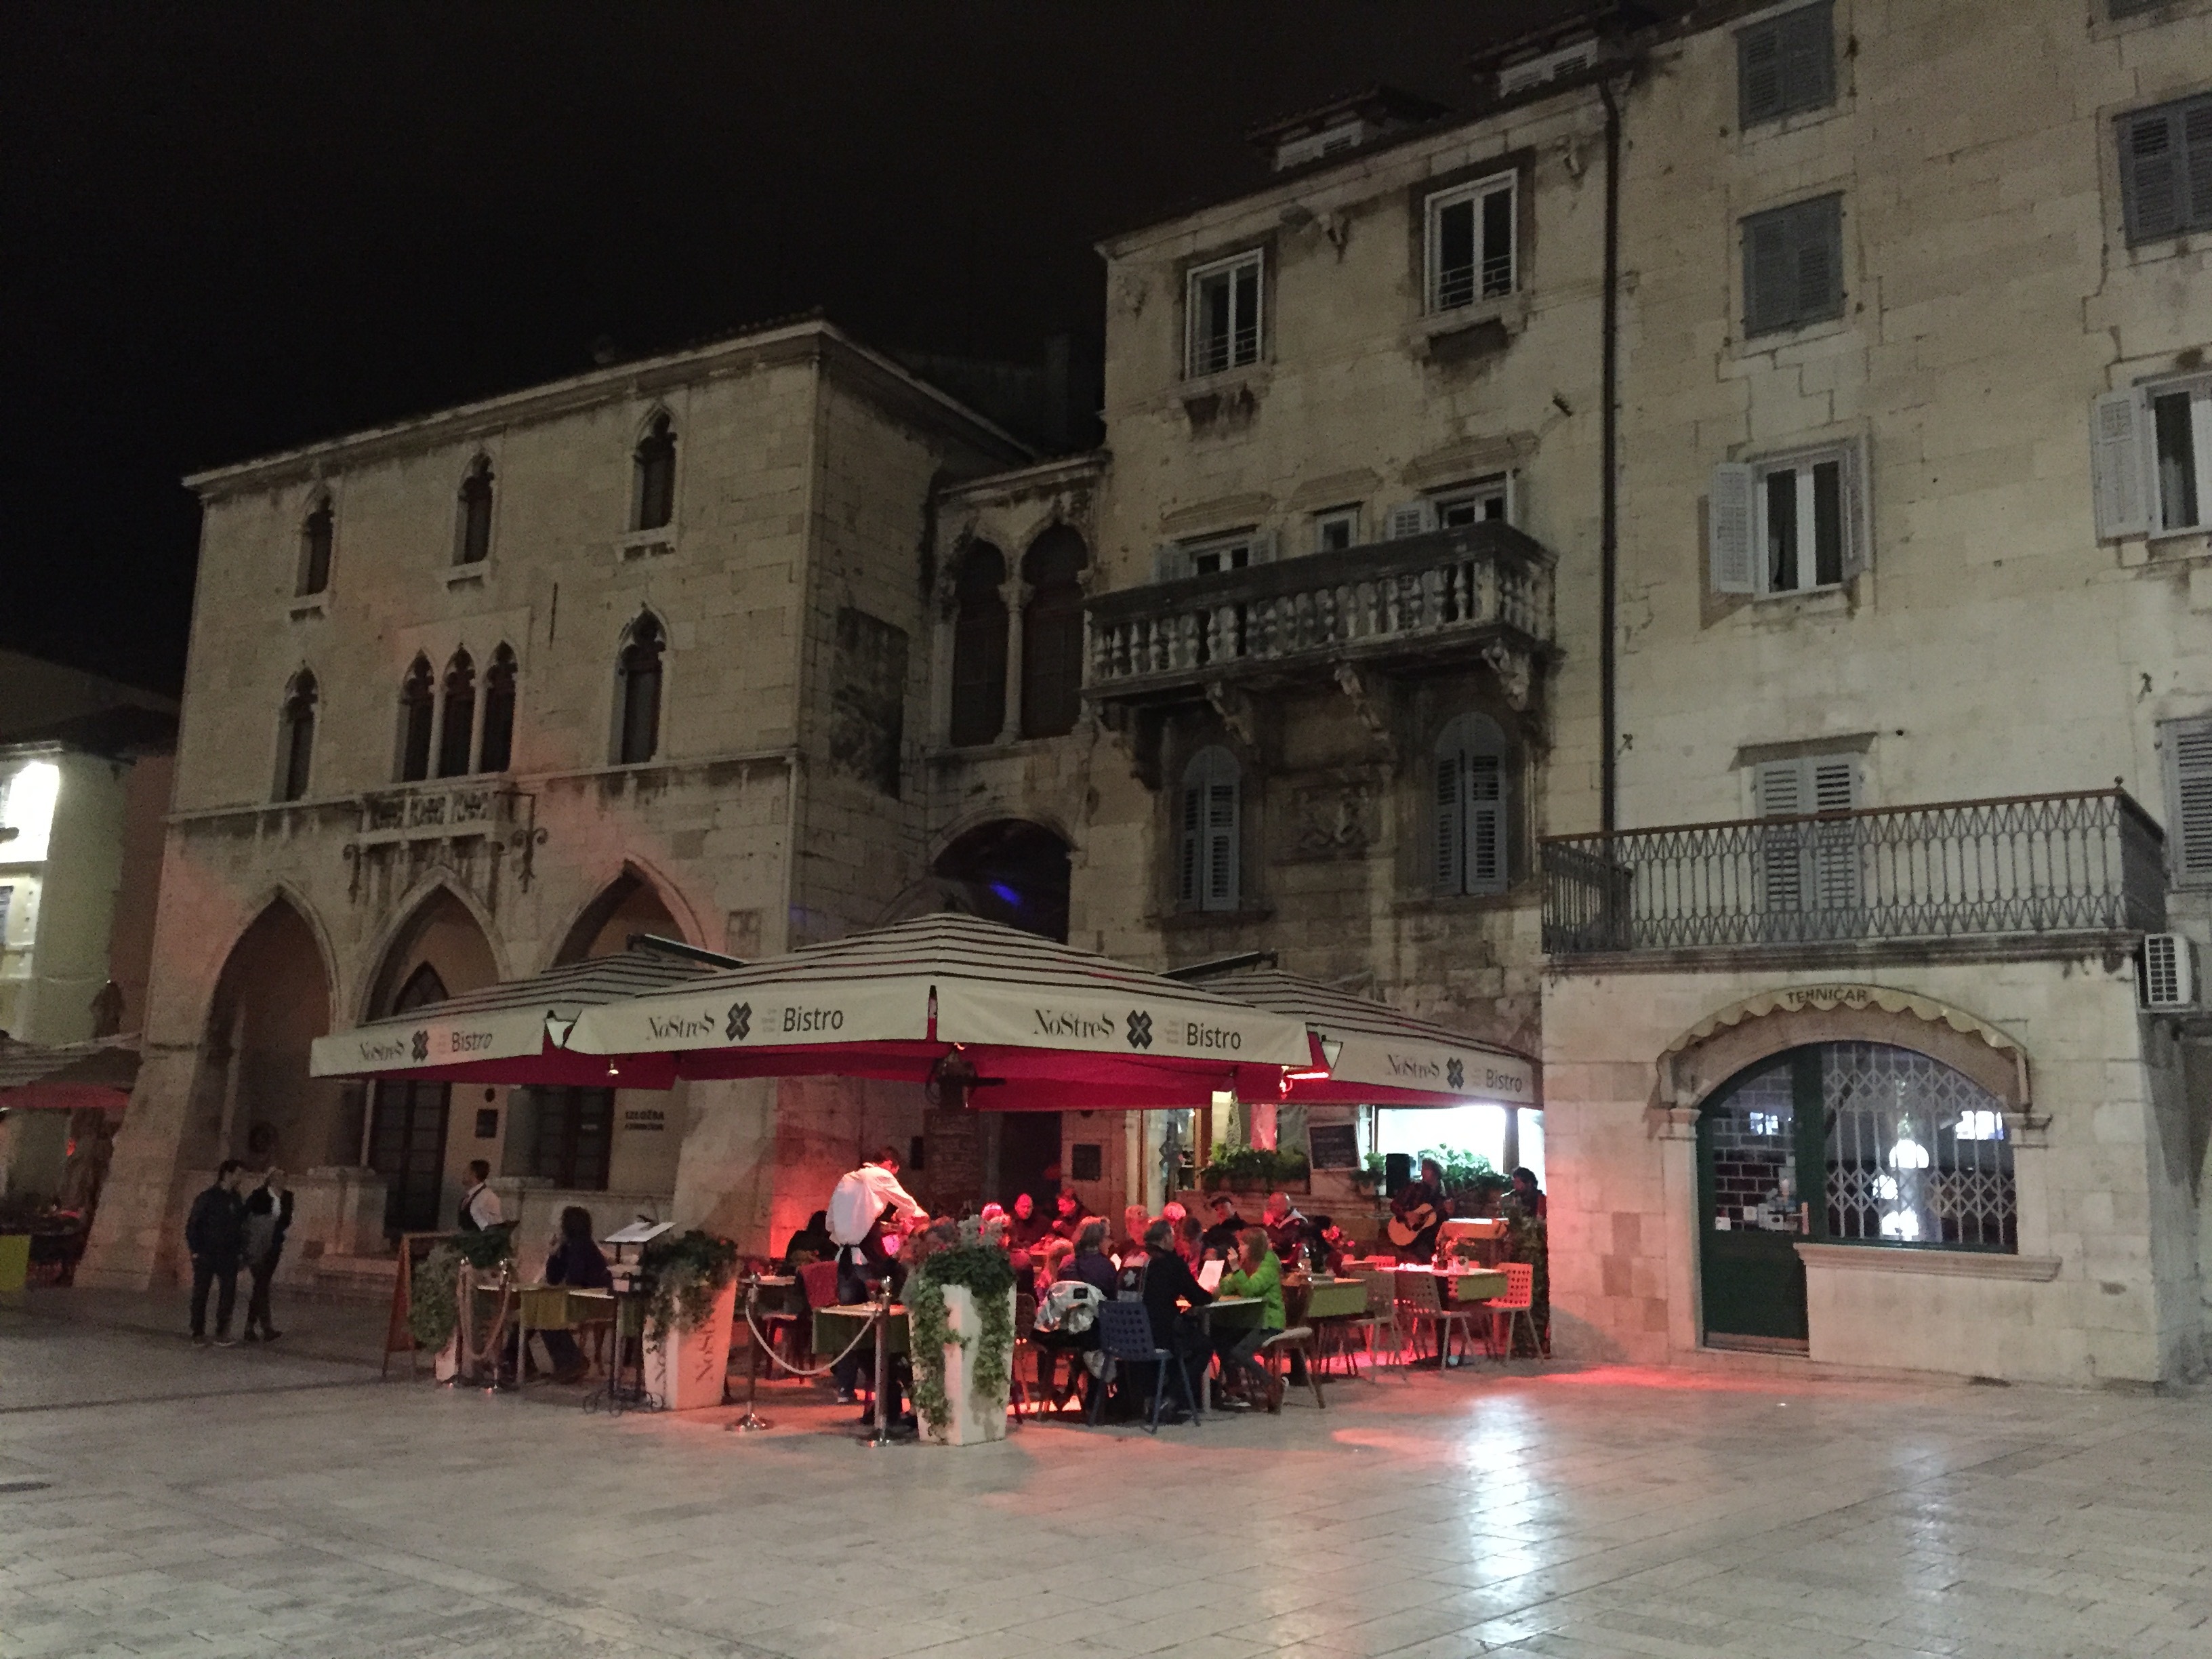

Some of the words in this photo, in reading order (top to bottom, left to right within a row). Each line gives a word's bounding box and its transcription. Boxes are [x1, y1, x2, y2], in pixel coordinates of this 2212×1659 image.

[783, 1006, 844, 1032] Bistro
[452, 1031, 493, 1052] Bistro
[1187, 1022, 1242, 1050] Bistro
[1486, 1069, 1522, 1092] Bistro
